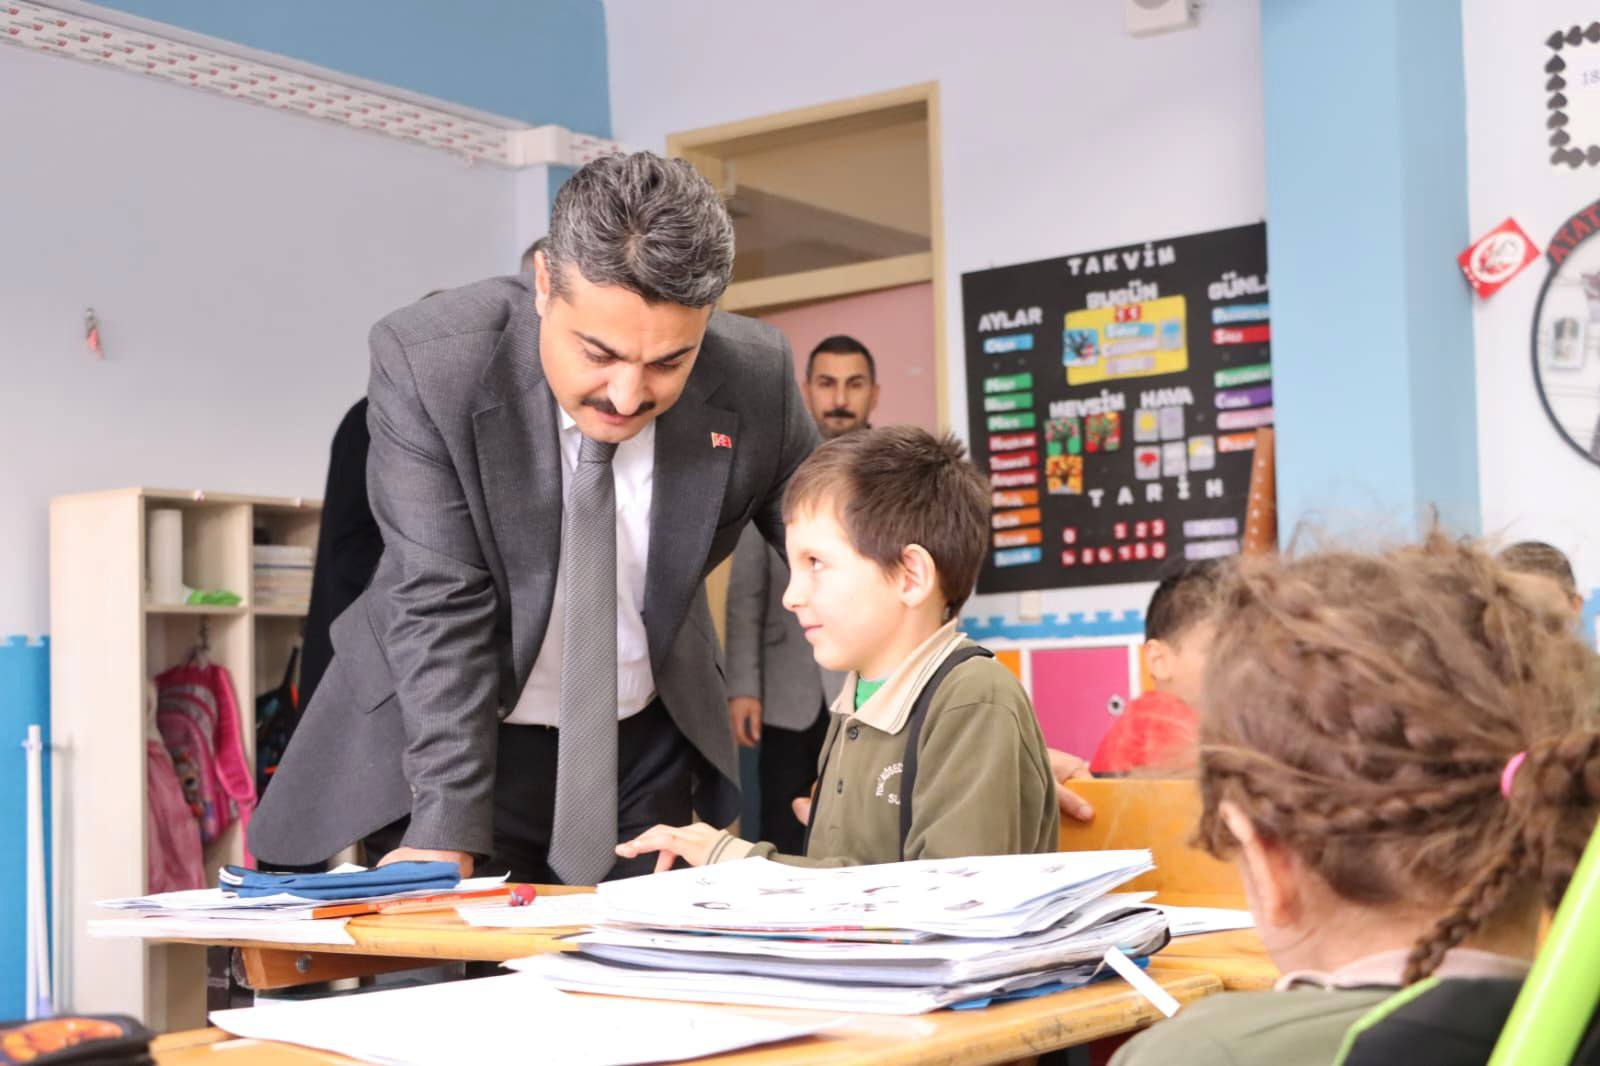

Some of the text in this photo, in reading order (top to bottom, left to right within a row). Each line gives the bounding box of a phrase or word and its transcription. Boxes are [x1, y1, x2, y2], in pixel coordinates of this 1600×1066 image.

[1067, 243, 1177, 276] TAKVİM
[1086, 280, 1159, 309] BUGÜN
[978, 307, 1044, 332] AYLAR
[1140, 386, 1194, 409] HAVA
